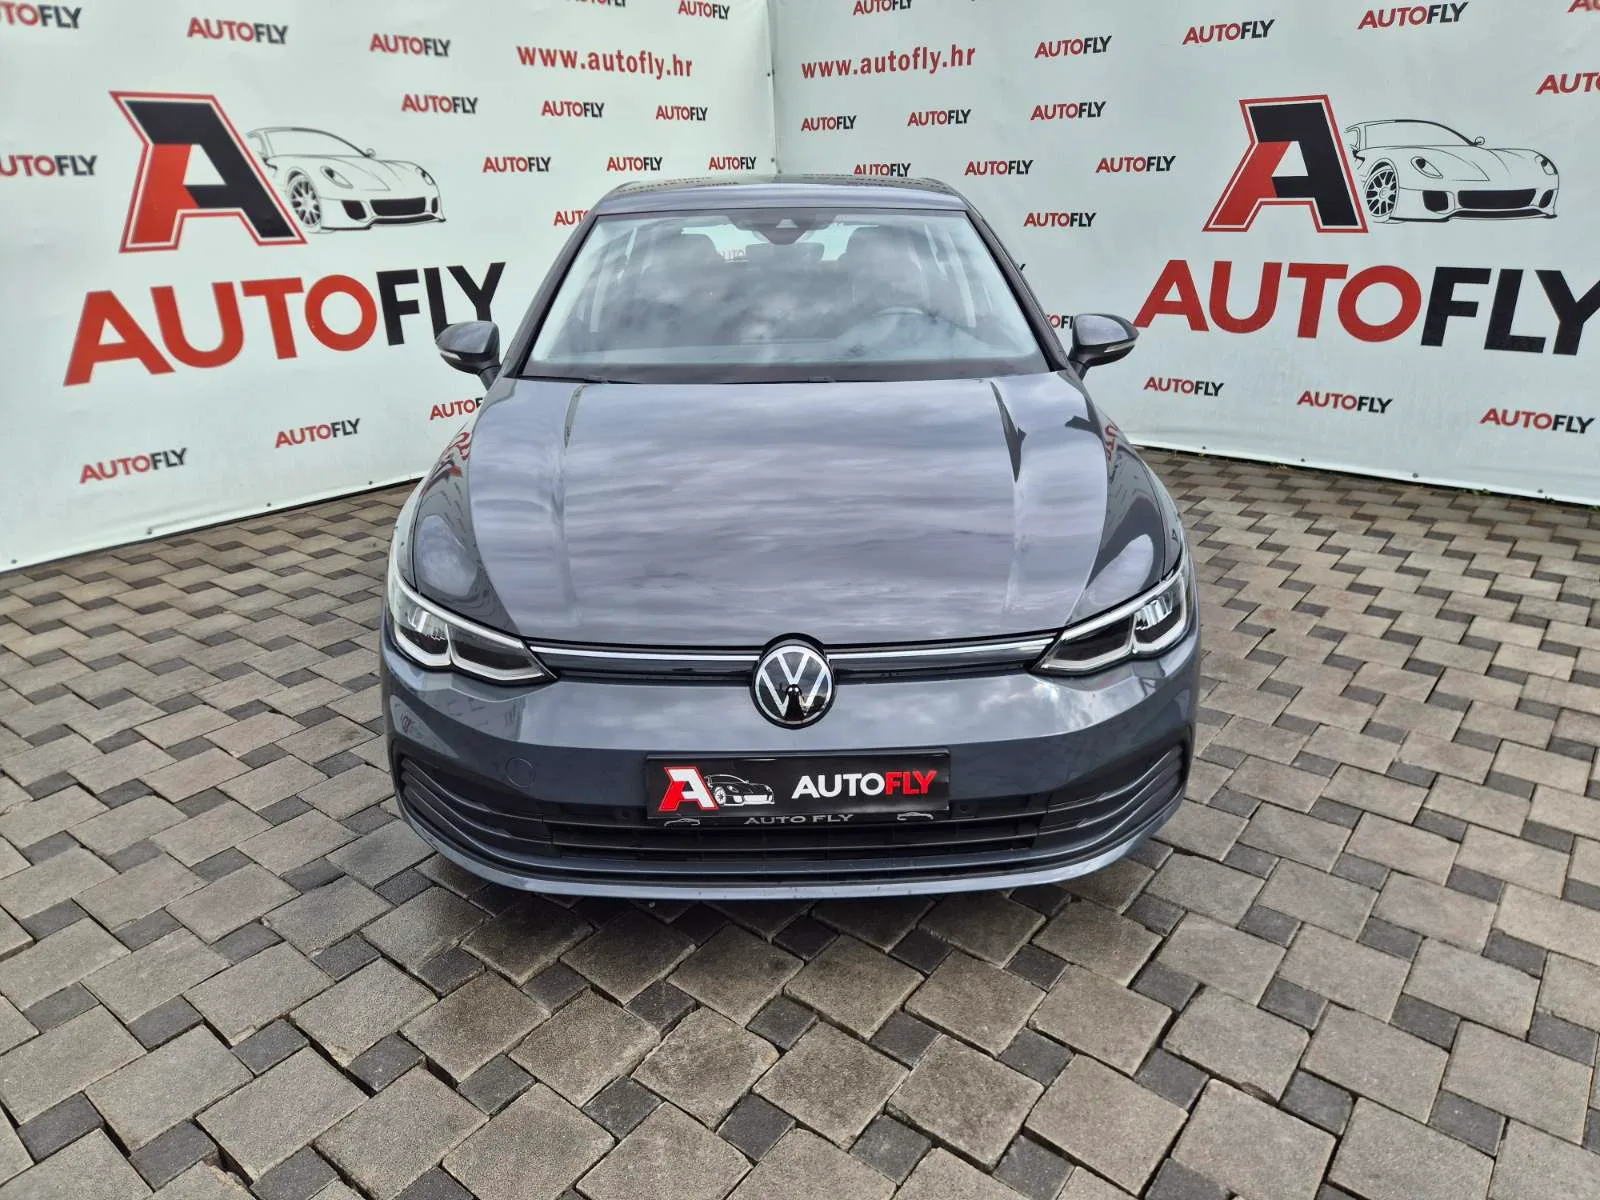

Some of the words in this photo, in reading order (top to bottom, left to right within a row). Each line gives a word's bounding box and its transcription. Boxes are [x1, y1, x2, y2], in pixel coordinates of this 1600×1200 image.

[0, 1, 82, 29] TOFLY
[677, 0, 731, 21] AUTOFLY
[1357, 1, 1469, 30] AUTOFLY
[186, 17, 289, 45] AUTOFLY
[1182, 18, 1276, 46] AUTOFLY
[369, 33, 451, 58] AUTOFLY
[1034, 35, 1113, 59] AUTOFLY
[515, 45, 694, 81] www.autofly.hr
[801, 43, 976, 80] www.autofly.hr
[1535, 71, 1600, 96] AUT
[401, 93, 479, 115] AUTOFLY
[541, 100, 605, 119] AUTOFLY
[655, 105, 709, 122] AUTOFLY
[1030, 100, 1107, 121] AUTOFLY
[800, 114, 857, 132] AUTOFLY
[907, 108, 972, 127] AUTOFLY
[0, 154, 98, 177] UTOFLY
[482, 156, 552, 174] AUTOFLY
[606, 156, 663, 172] AUTOFLY
[708, 156, 757, 171] AUTOFLY
[963, 159, 1034, 176] AUTOFLY
[1095, 155, 1177, 174] AUTOFLY
[1023, 212, 1097, 228] AUTOFLY
[1134, 258, 1600, 357] AUTOFLY
[63, 261, 506, 386] AUTOFLY
[1143, 376, 1225, 397] AUTOFLY
[1296, 390, 1394, 415] AUTOFLY
[1479, 407, 1596, 435] AUTOFLY
[275, 417, 361, 449] AUTOFLY
[79, 447, 188, 484] AUTOFLY
[791, 770, 938, 800] AUTOFLY
[744, 815, 806, 825] AUTO
[812, 814, 854, 823] FLY
